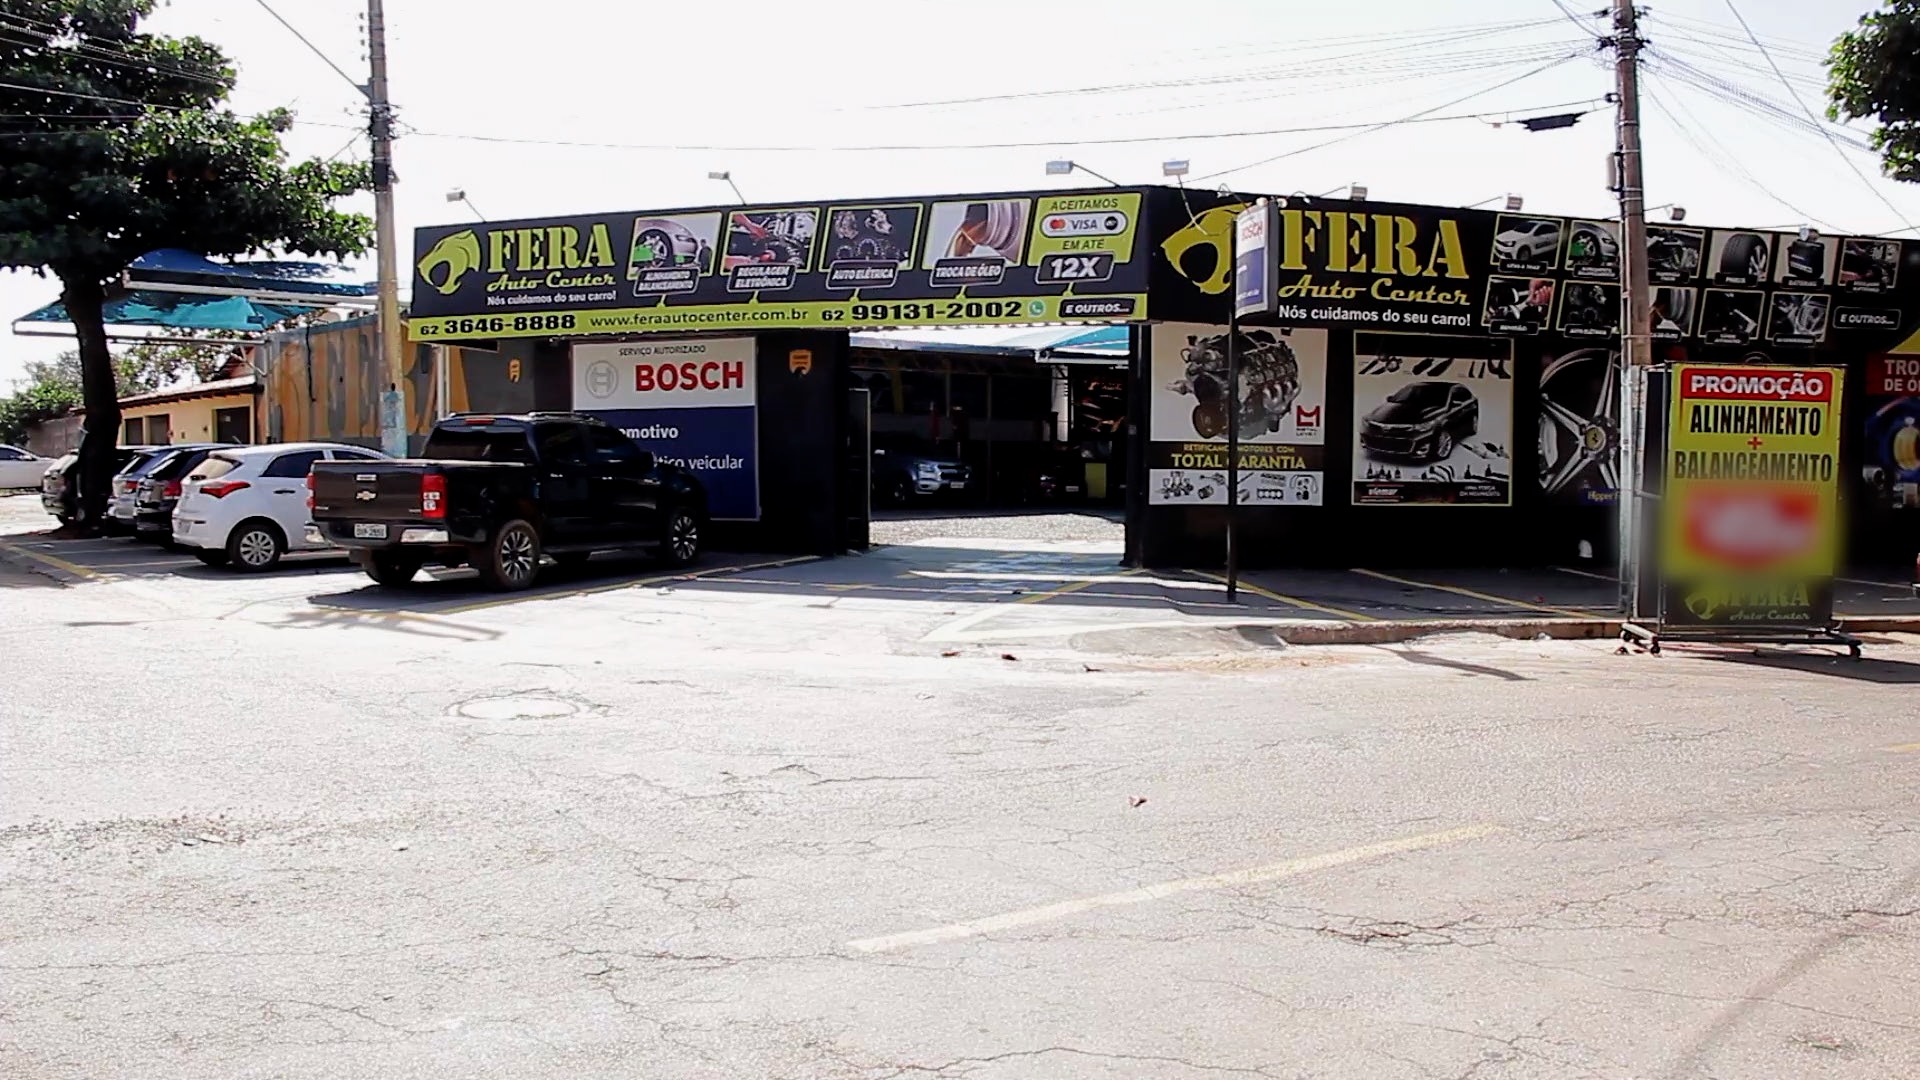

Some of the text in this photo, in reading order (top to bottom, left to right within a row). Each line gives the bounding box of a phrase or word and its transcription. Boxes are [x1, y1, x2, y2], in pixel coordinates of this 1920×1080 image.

[1051, 198, 1118, 211] ACEITAMOS
[1070, 219, 1098, 230] VISA
[487, 223, 616, 273] FERA
[1062, 240, 1079, 250] EM
[1279, 209, 1470, 280] FERA
[737, 266, 790, 277] REGULAGEM
[832, 266, 894, 280] AUTO ELÉTRICA
[935, 263, 1001, 278] TROCA DE ÓLEO
[1051, 257, 1101, 279] 12X
[486, 270, 616, 293] Auto Center
[1277, 274, 1367, 299] Auto
[1371, 277, 1471, 306] Center
[487, 290, 617, 306] Nós cuidamos do seu carro!
[590, 308, 809, 327] www.feraautocenter.com.br
[821, 301, 1021, 321] 62 99131-2002
[1065, 305, 1074, 313] E
[1278, 304, 1471, 327] Nós cuidamos do seu carro!
[420, 314, 576, 335] 62 3646-8888
[1840, 314, 1847, 323] E
[619, 345, 706, 357] SERVIÇO AUTORIZADO
[635, 361, 743, 391] BOSCH
[1884, 359, 1920, 376] TRO
[1691, 372, 1824, 400] PROMOÇÃO
[1884, 378, 1904, 392] DE
[1690, 404, 1821, 436] ALINHAMENTO
[688, 454, 744, 470] veicular
[1171, 453, 1306, 469] TOTAL ARANTIA
[1674, 451, 1832, 482] BALANCEAMENTO
